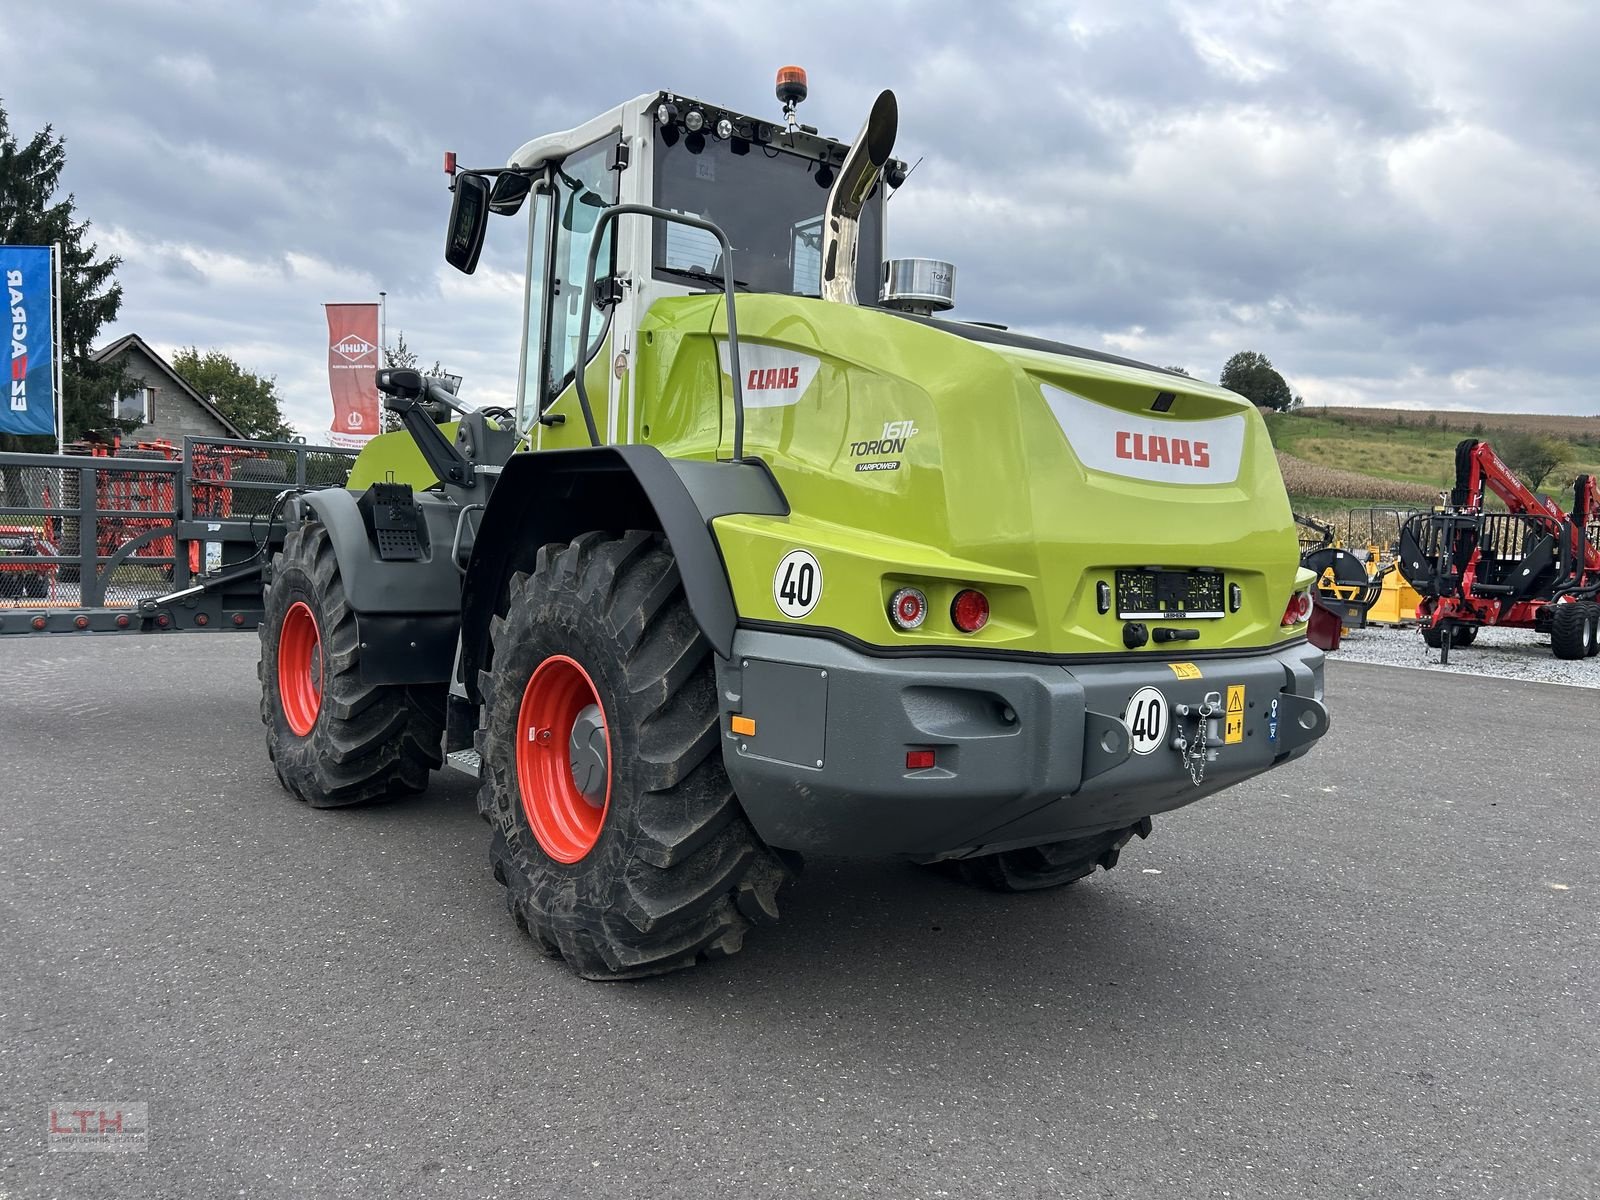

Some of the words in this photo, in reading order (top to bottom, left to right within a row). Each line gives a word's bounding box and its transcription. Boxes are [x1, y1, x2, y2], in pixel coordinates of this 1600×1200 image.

[746, 366, 800, 390] CLAAS
[850, 438, 907, 457] TORION
[1116, 430, 1210, 468] CLAAS
[859, 462, 897, 471] VARIPOWER
[780, 562, 814, 607] 40
[1132, 698, 1161, 742] 40
